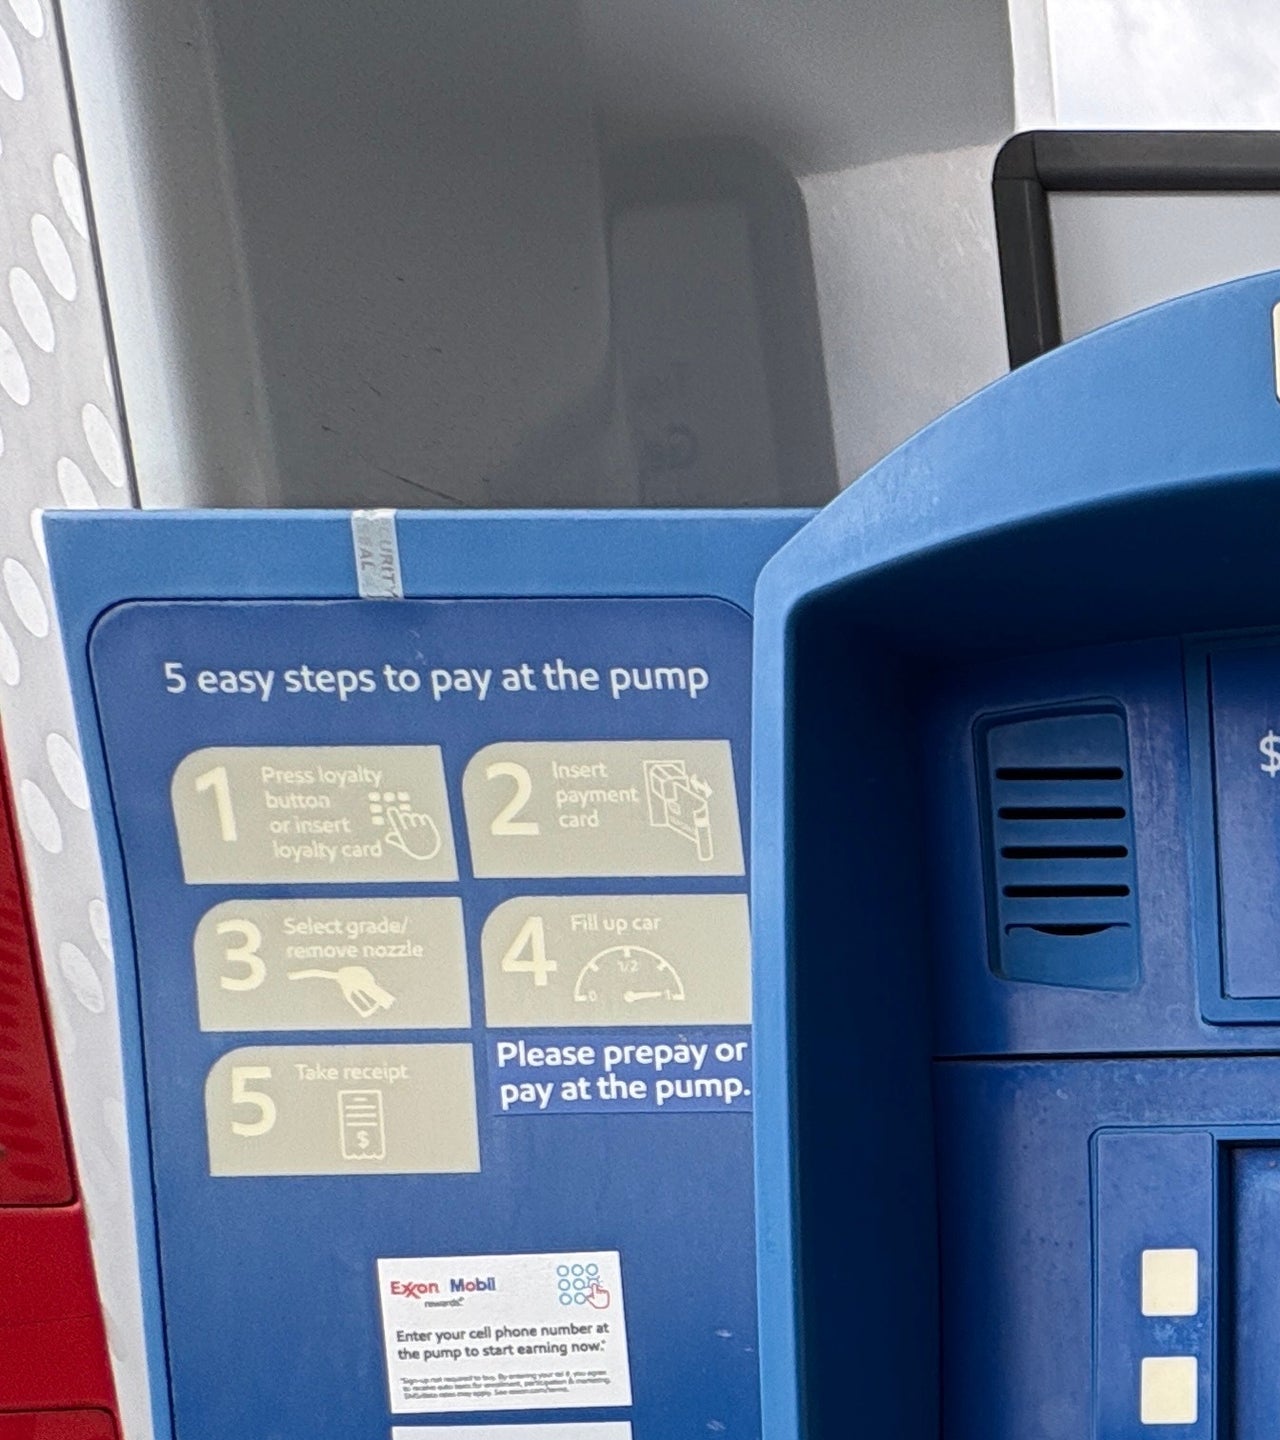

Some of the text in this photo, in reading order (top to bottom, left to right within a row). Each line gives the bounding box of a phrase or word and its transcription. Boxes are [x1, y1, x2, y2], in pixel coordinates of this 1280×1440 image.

[165, 662, 708, 701] 5 easy steps to pay at the pump
[261, 765, 382, 786] Press loyalty
[552, 761, 607, 779] Insert
[195, 765, 238, 841] 1
[265, 791, 330, 809] button
[485, 762, 540, 835] 2
[555, 786, 639, 806] payment
[270, 815, 350, 834] or insert
[559, 809, 599, 828] card
[273, 840, 382, 861] loyalty card
[284, 916, 409, 938] Select grade/
[571, 914, 661, 934] Fill up car
[215, 920, 266, 991] 3
[286, 940, 424, 959] remove nozzle
[501, 916, 557, 985] 4
[497, 1040, 747, 1072] Please prepay or
[295, 1063, 409, 1083] Take receipt
[230, 1066, 277, 1136] 5
[500, 1075, 751, 1109] pay at the pump.
[390, 1277, 496, 1299] Exxon Mobil
[396, 1323, 609, 1343] Enter your cell phone number at
[398, 1342, 567, 1362] the pump to earning
